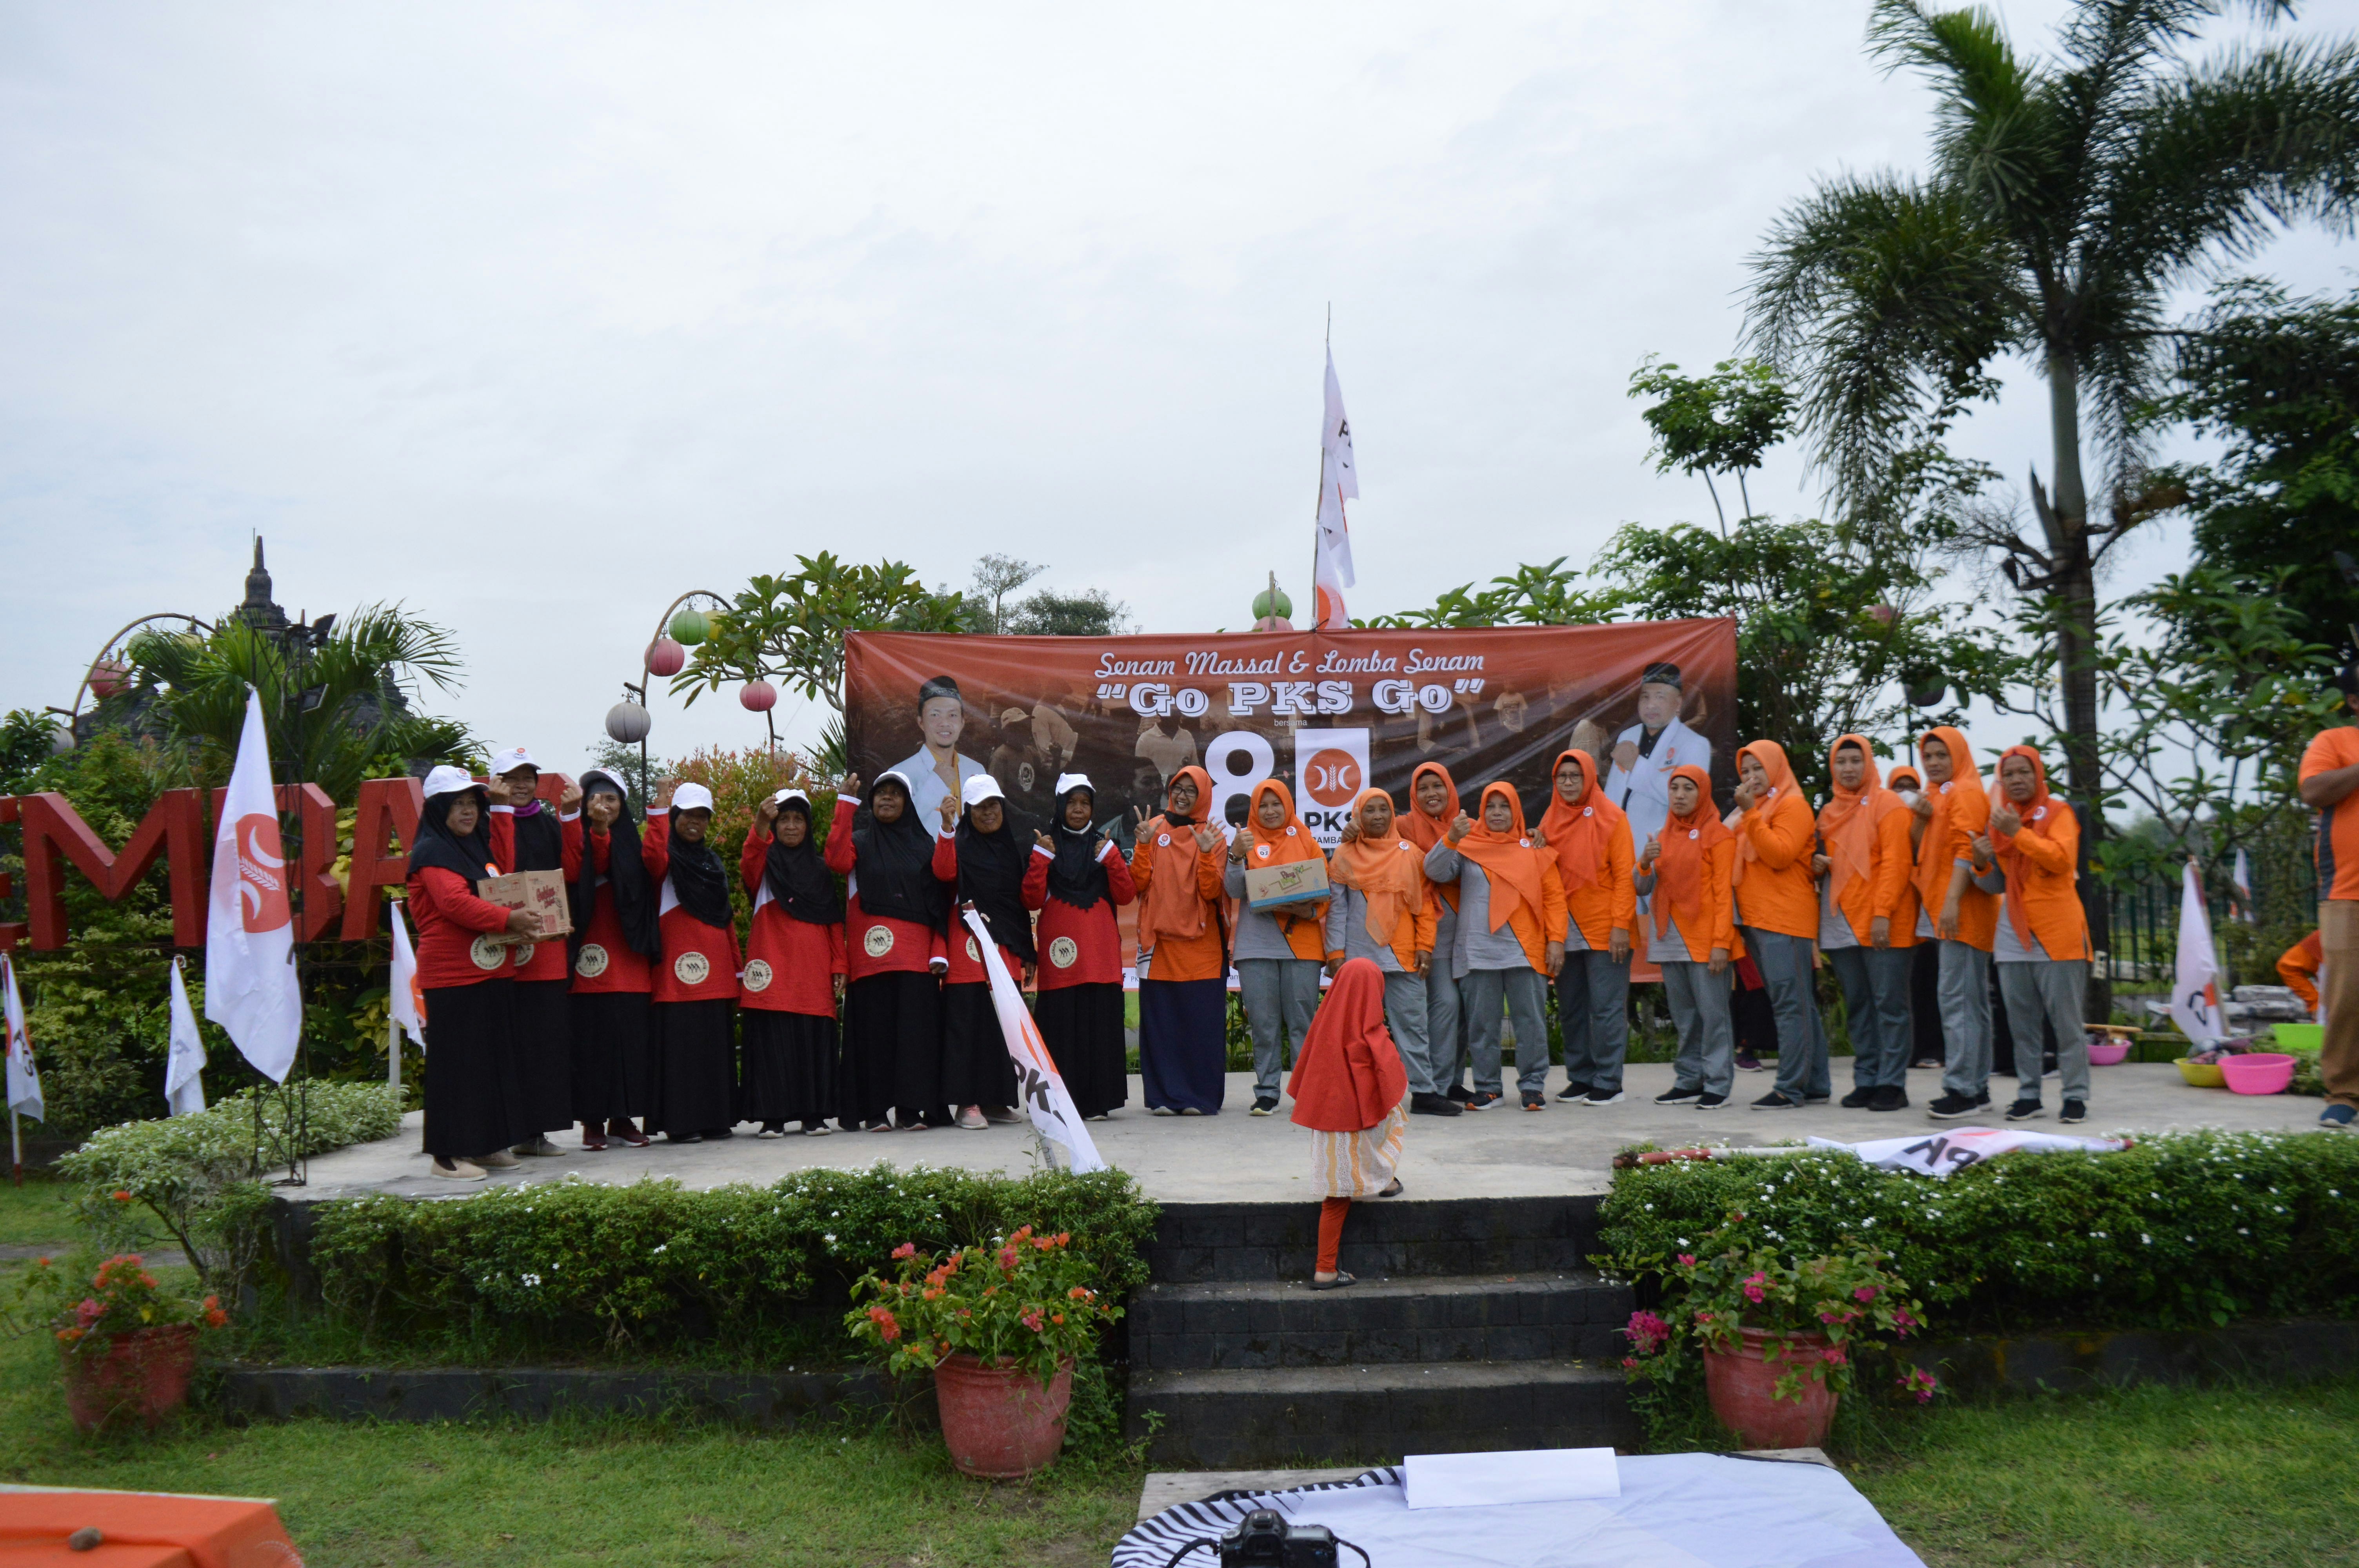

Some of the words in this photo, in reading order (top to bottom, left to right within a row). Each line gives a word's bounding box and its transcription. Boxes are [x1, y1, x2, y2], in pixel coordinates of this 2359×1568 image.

[1095, 652, 1175, 678] Senam
[1185, 651, 1283, 675] Massal
[1288, 650, 1309, 673] &
[1316, 650, 1397, 673] Lomba
[1403, 648, 1483, 674] Senam
[1228, 680, 1352, 716] PKS
[1205, 731, 1274, 847] 8
[1011, 1055, 1068, 1129] PK
